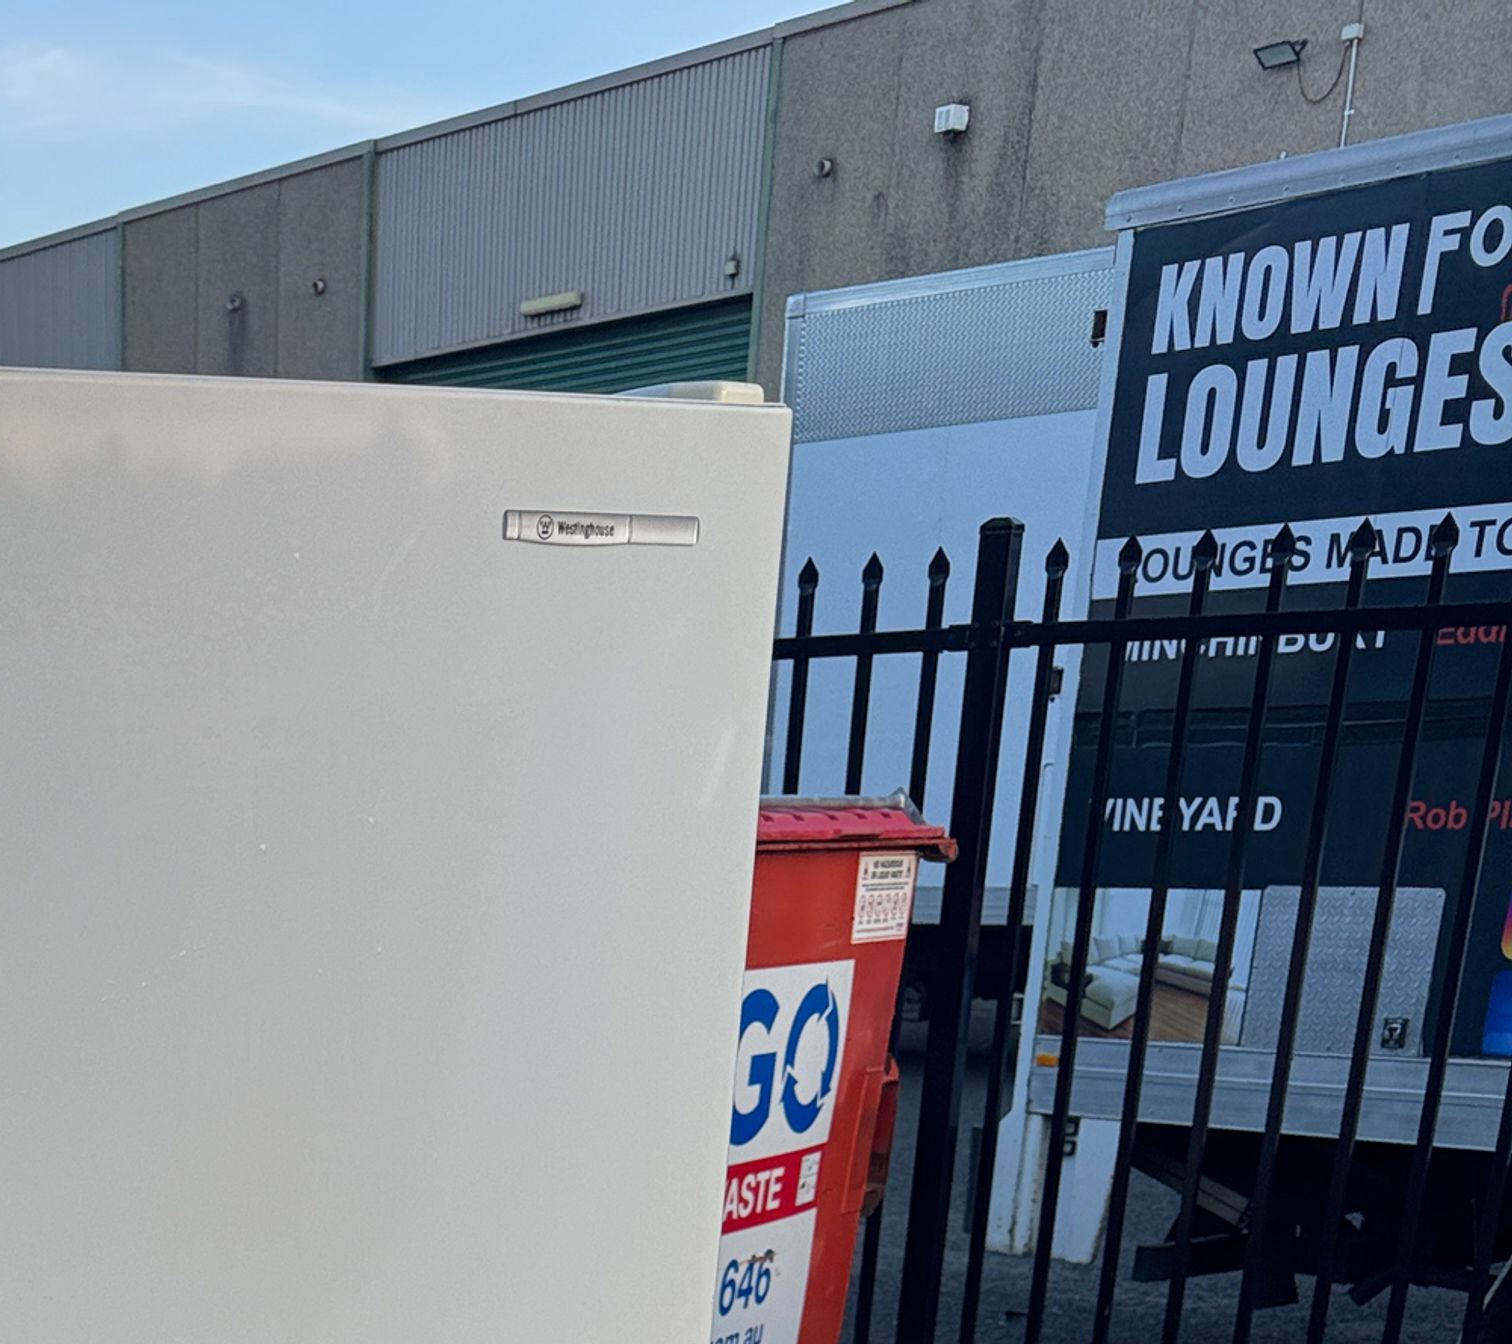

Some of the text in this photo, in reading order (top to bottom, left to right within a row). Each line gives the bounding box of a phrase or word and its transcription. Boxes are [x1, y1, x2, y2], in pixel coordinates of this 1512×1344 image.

[1151, 204, 1512, 355] KNOWN FO
[1135, 320, 1512, 485] LOUNGES
[557, 519, 616, 540] Westinghouse
[1126, 534, 1312, 583] OUNGES
[1406, 799, 1469, 831] Rob
[729, 977, 840, 1147] GO
[723, 1165, 786, 1222] ASTE
[718, 1253, 771, 1317] 646
